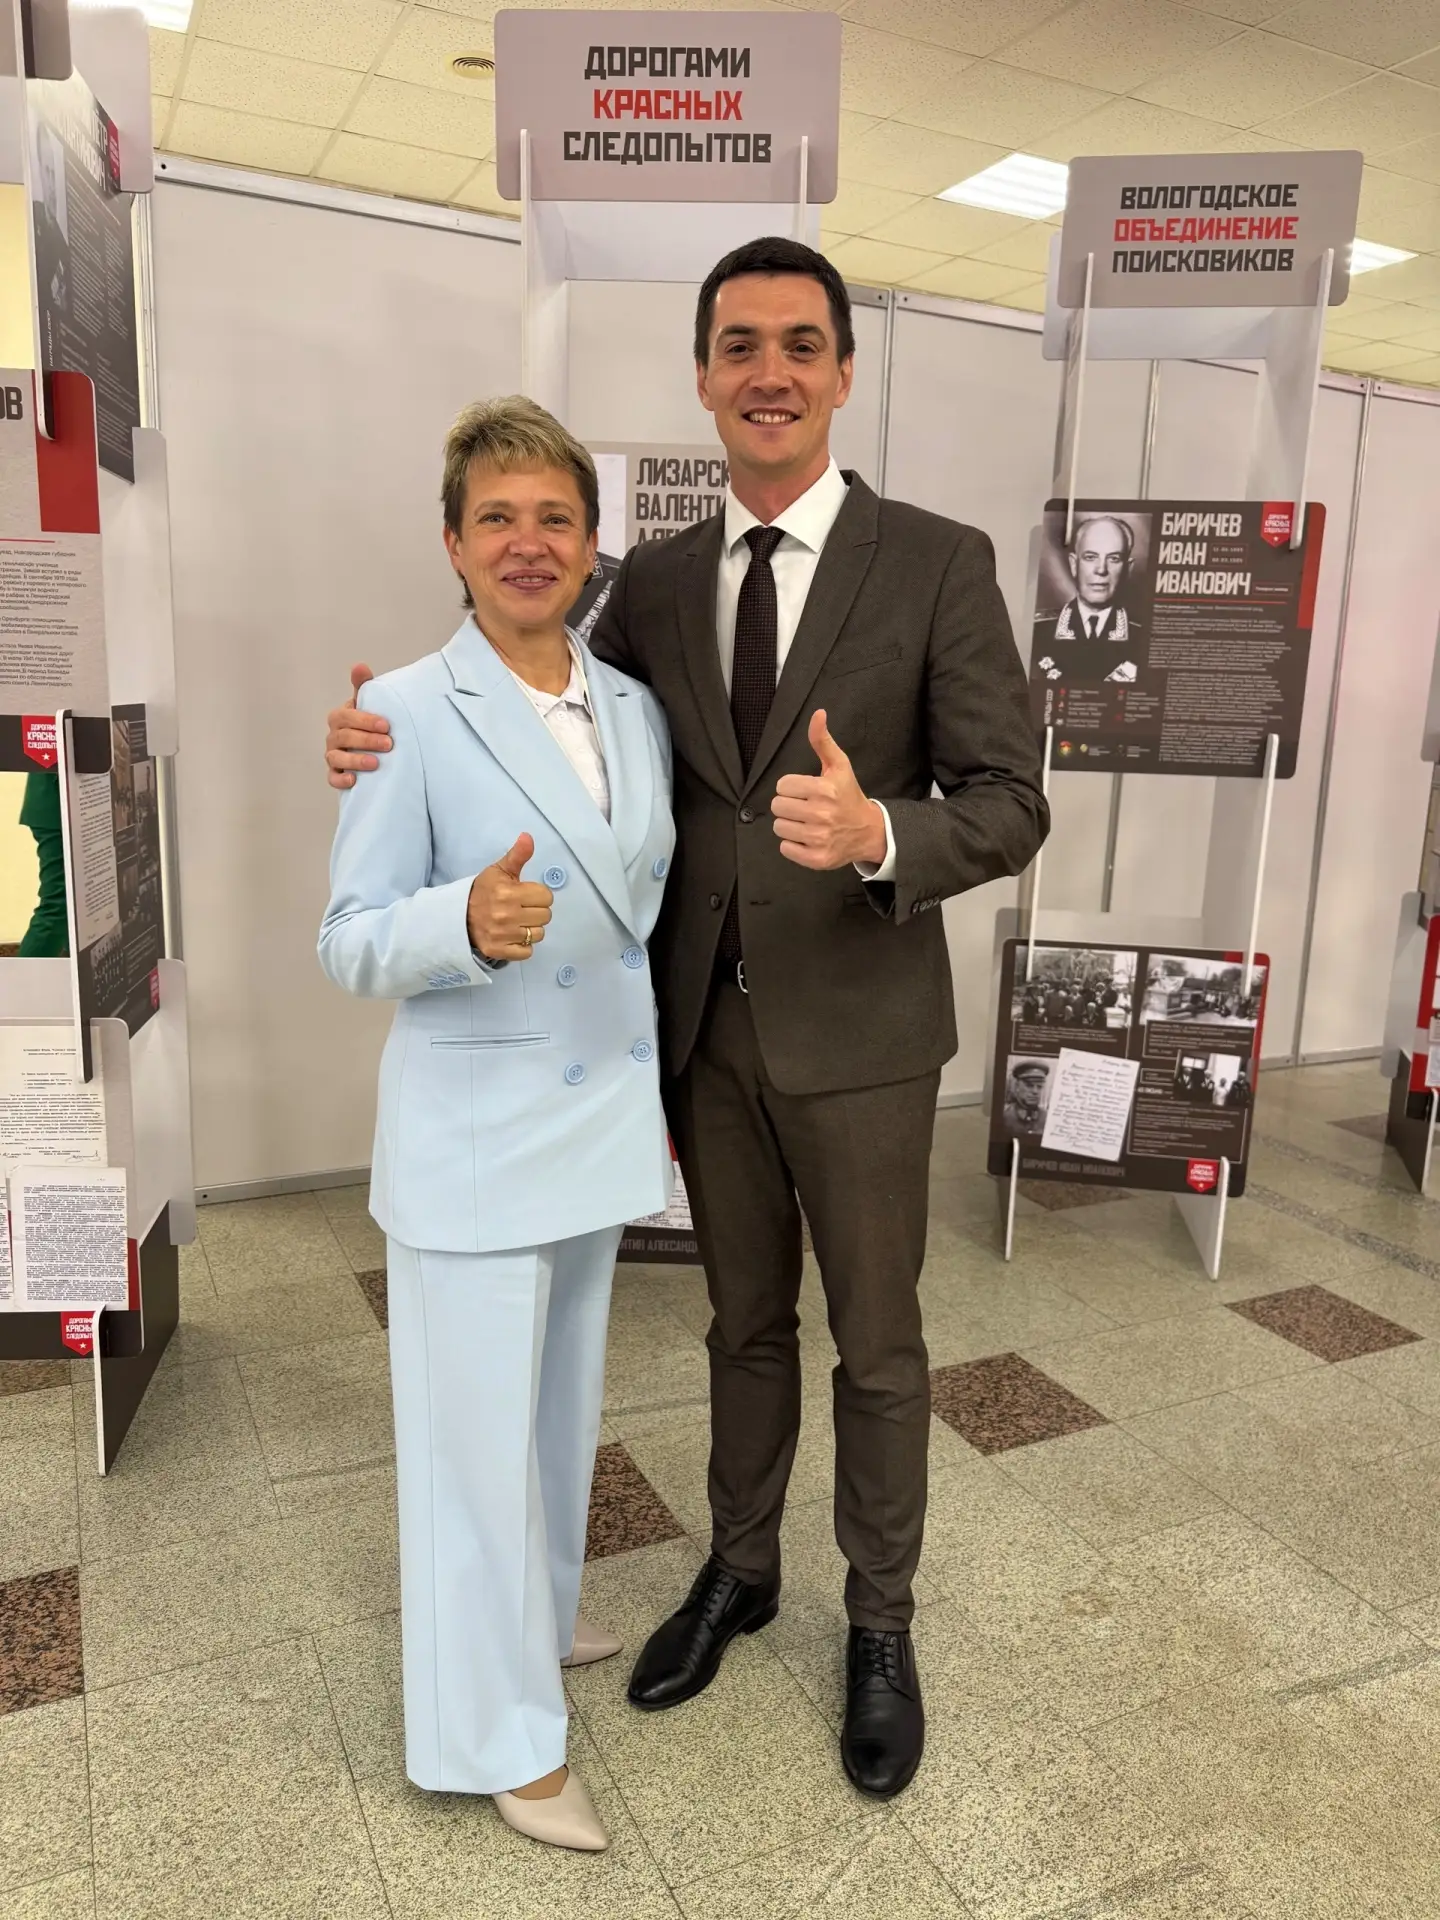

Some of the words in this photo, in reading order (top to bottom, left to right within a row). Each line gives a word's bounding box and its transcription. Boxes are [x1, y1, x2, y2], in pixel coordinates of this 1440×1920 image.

[584, 46, 751, 80] ДОРОГАМИ
[594, 89, 743, 120] КРАСНЫХ
[563, 131, 772, 165] СЛЕДОПЫТОВ
[1120, 184, 1299, 211] ВОЛОГОДСКОЕ
[1114, 216, 1299, 243] ОБЪЕДИНЕНИЕ
[1112, 248, 1294, 273] ПОИСКОВИКОВ
[636, 458, 730, 488] ЛИЗАРСК
[1161, 512, 1242, 537] БИРИЧЕВ
[1158, 541, 1207, 565] ИВАН
[1155, 570, 1251, 595] ИВАНОВИЧ
